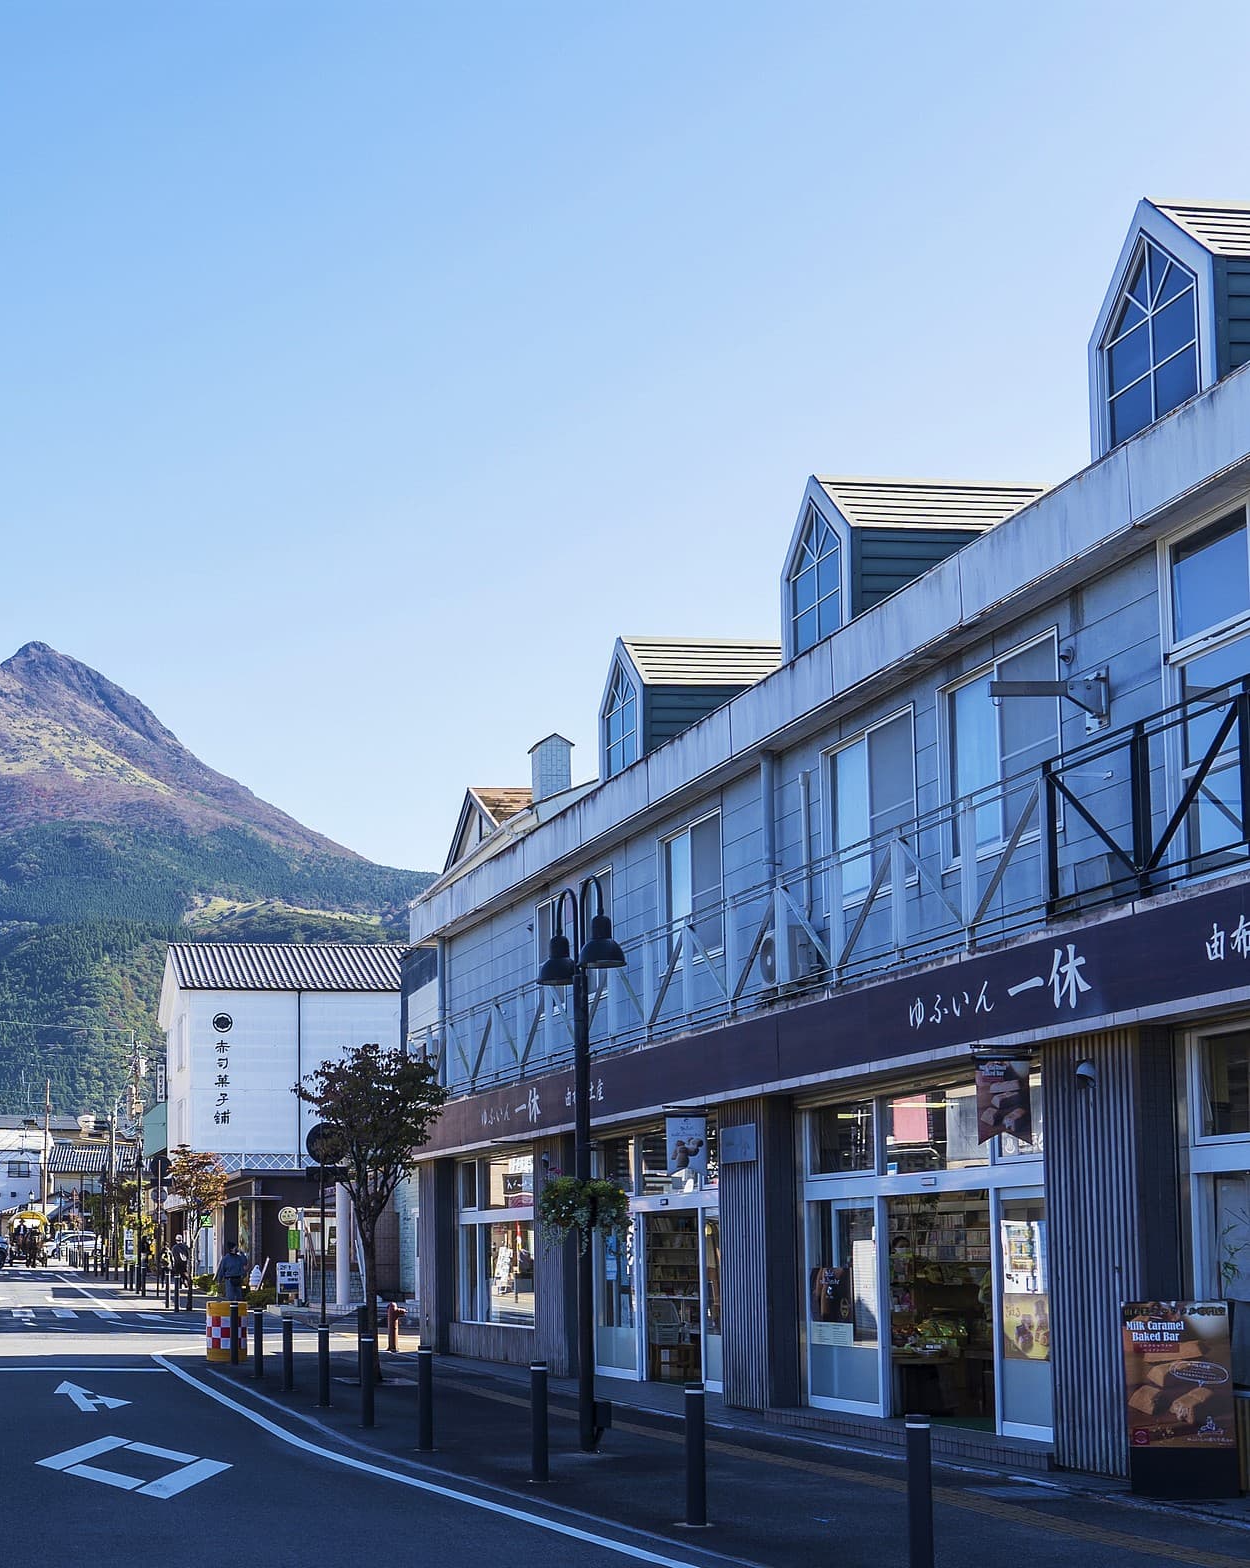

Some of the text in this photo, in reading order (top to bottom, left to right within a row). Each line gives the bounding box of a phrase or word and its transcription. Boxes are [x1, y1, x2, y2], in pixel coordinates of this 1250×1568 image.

[908, 942, 1093, 1030] ゆふいん 一休
[213, 1039, 231, 1125] 赤司菓子舗
[514, 1087, 542, 1123] 一休
[1126, 1320, 1185, 1331] Milk Caramel
[1132, 1331, 1180, 1342] Baked Bar
